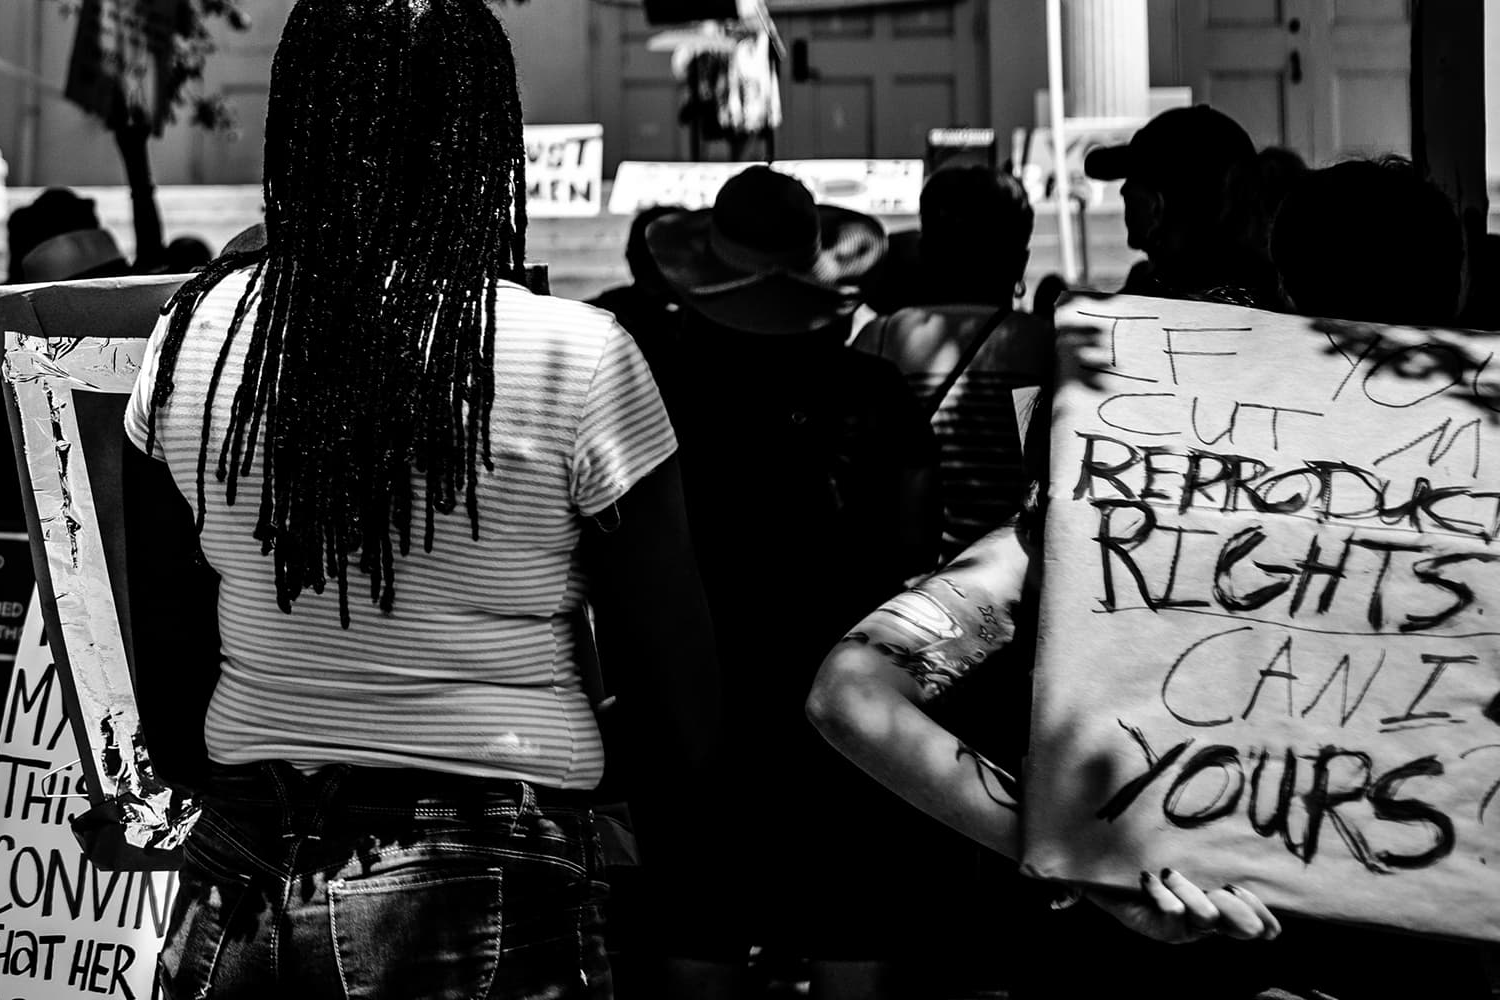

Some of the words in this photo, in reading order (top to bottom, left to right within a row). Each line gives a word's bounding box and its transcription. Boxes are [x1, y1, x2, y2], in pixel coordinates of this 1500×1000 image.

[1076, 310, 1253, 386] IF
[1097, 391, 1324, 451] CUT
[1090, 500, 1500, 633] RIGHTS
[1161, 626, 1387, 729] CAN
[1379, 653, 1480, 733] I
[67, 939, 136, 1000] HER
